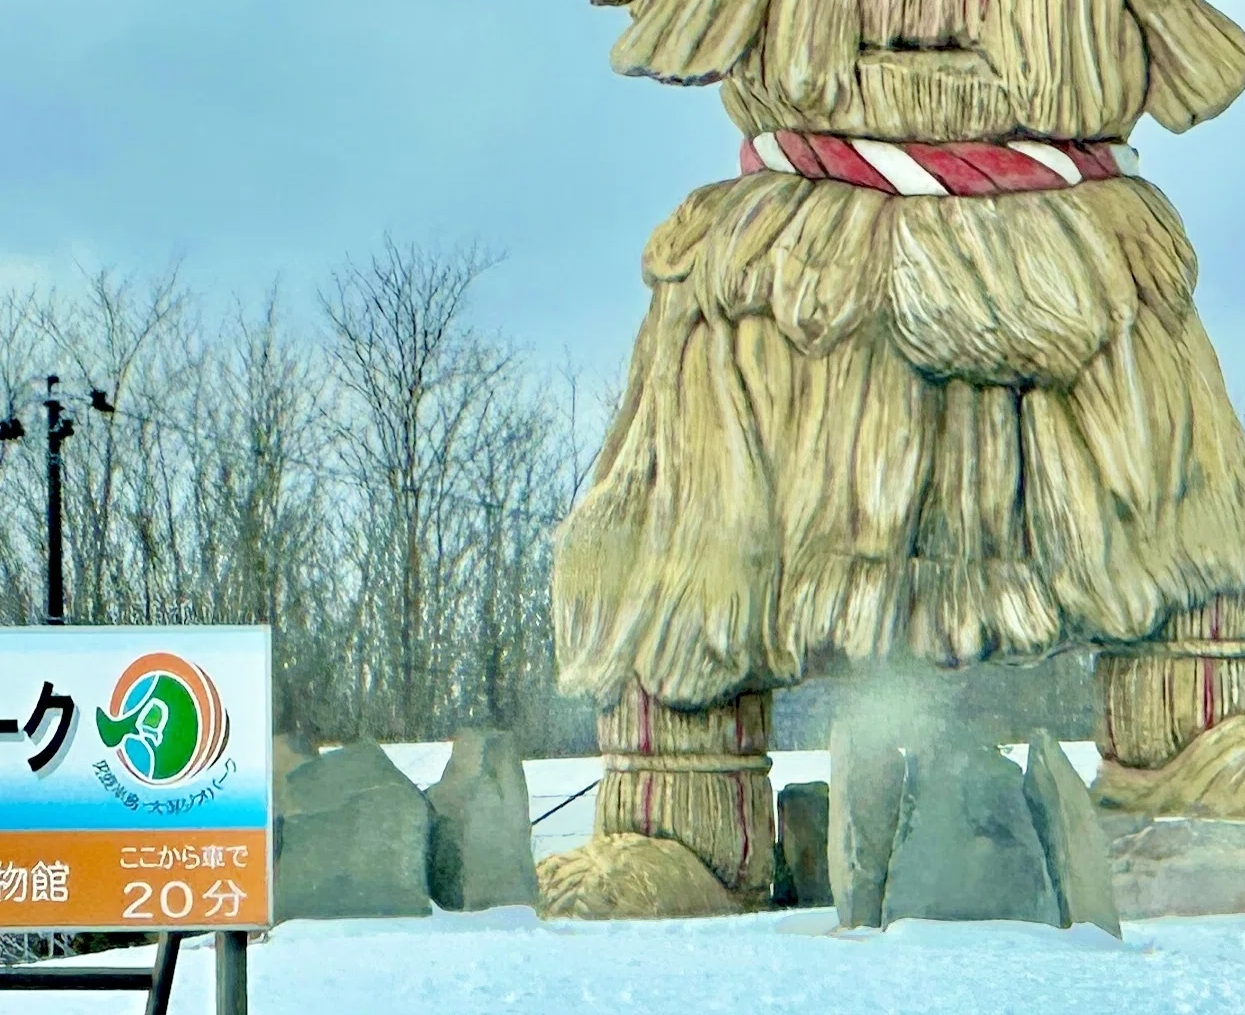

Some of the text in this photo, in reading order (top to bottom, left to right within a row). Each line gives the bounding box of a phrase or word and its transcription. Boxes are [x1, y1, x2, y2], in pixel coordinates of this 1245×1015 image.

[120, 845, 249, 869] ここから車で
[0, 860, 70, 903] 物館
[122, 879, 248, 919] 20分
